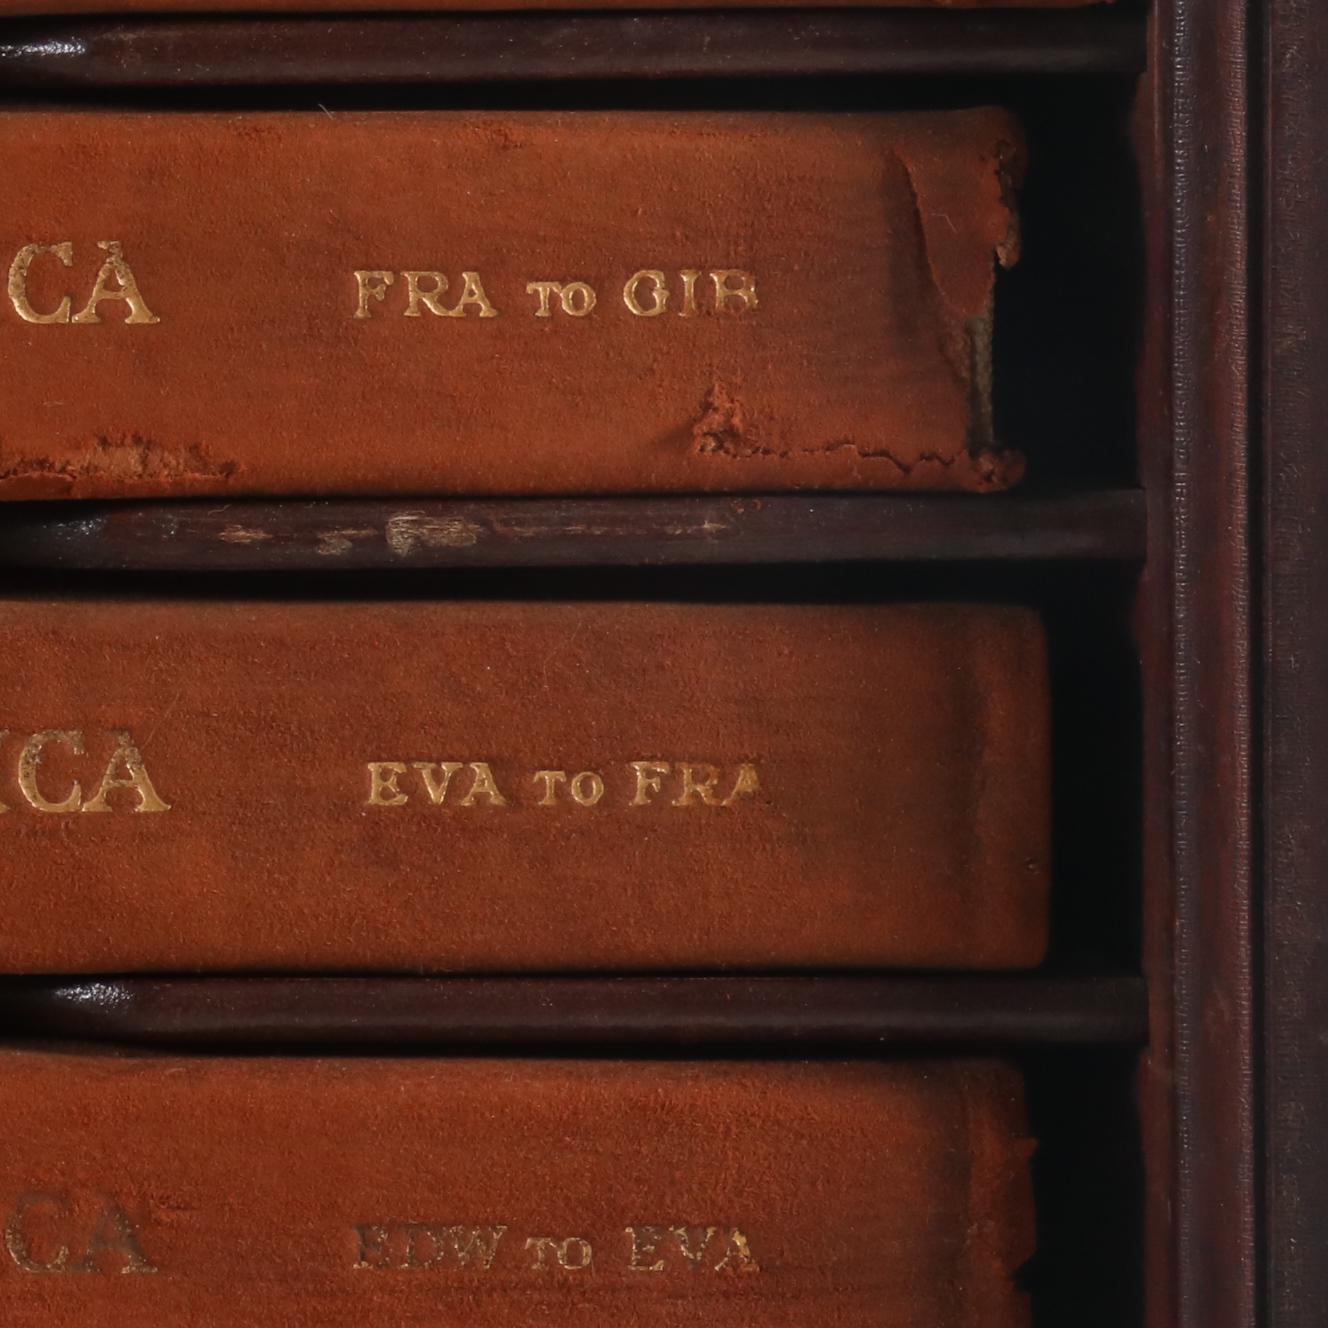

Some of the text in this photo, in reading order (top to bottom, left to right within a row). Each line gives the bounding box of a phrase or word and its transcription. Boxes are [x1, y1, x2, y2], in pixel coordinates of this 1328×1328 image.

[352, 269, 501, 320] FRA
[622, 268, 760, 317] GIB
[365, 761, 505, 807] EVA
[629, 760, 762, 807] FRA
[624, 1225, 761, 1273] EVA
